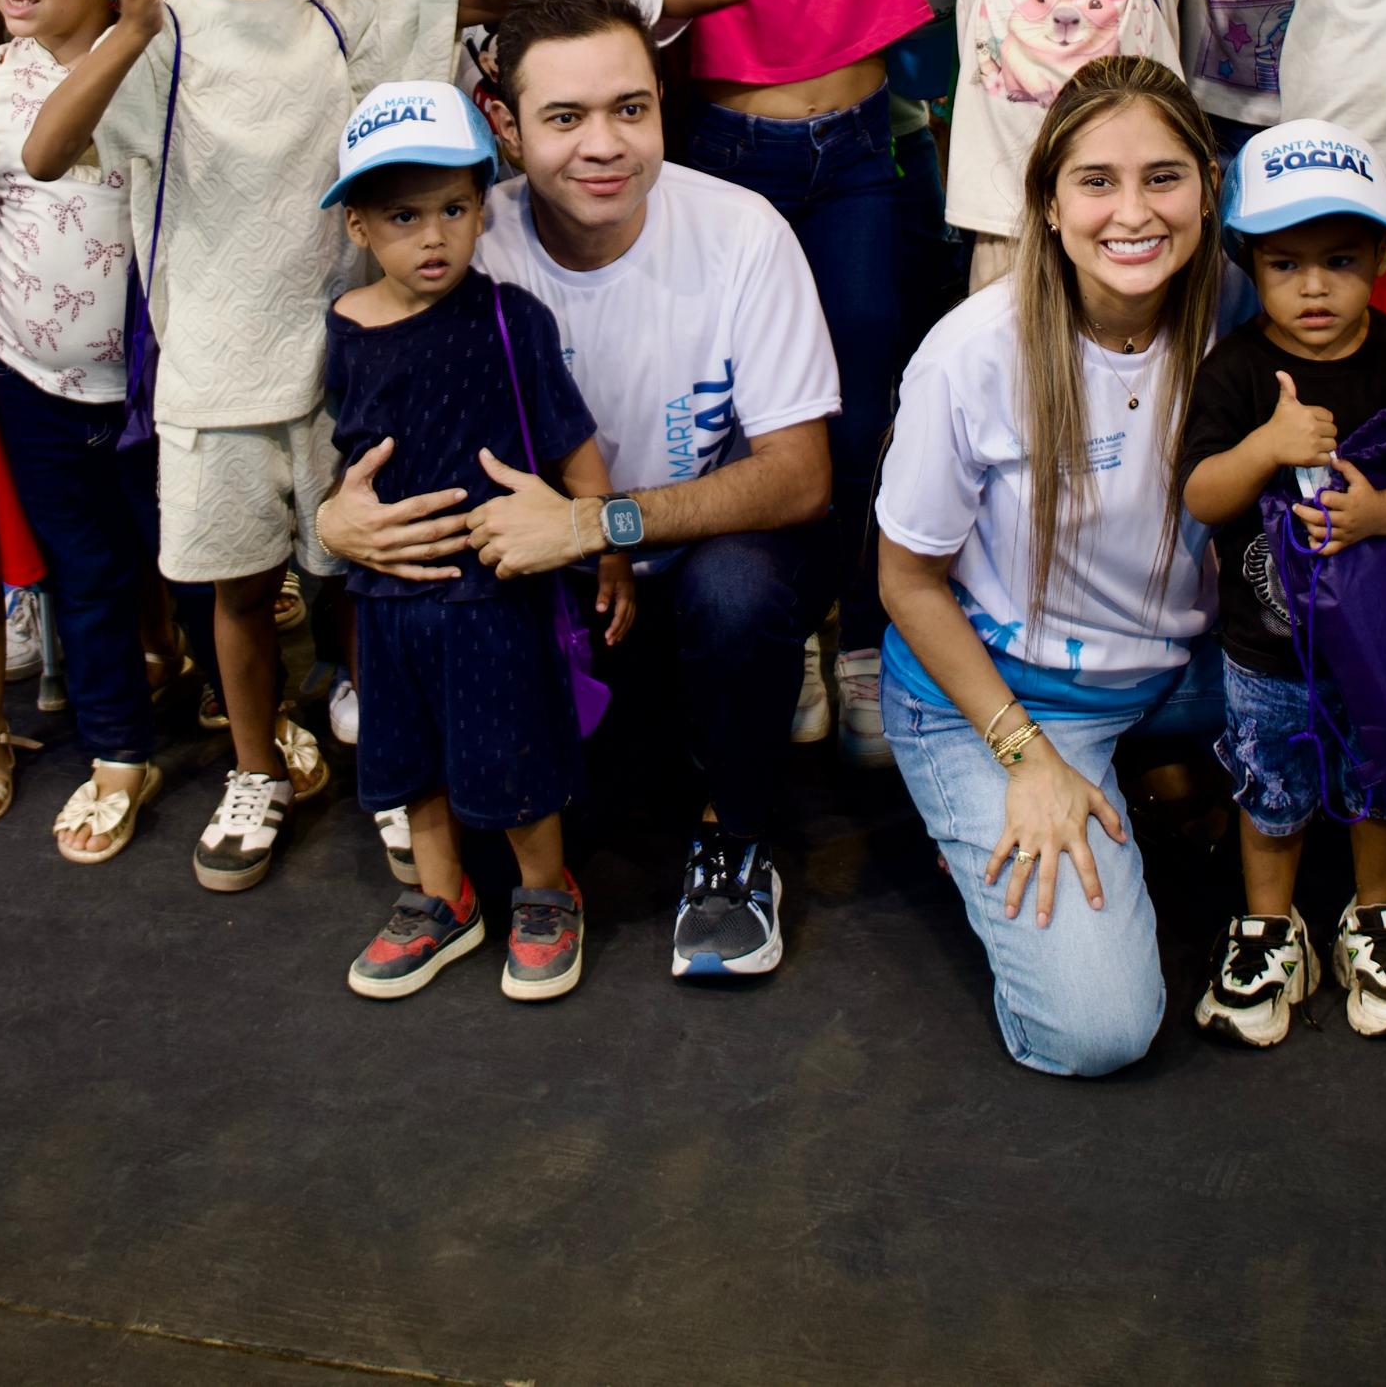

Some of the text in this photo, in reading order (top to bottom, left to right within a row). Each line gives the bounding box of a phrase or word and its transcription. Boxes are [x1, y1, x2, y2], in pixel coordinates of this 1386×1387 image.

[347, 95, 437, 131] SANTA MARTA
[347, 105, 437, 149] SOCIAL
[1260, 140, 1372, 165] SANTA MARTA
[1263, 149, 1374, 182] SOCIAL
[666, 393, 694, 479] MARTA
[692, 358, 735, 479] IAL
